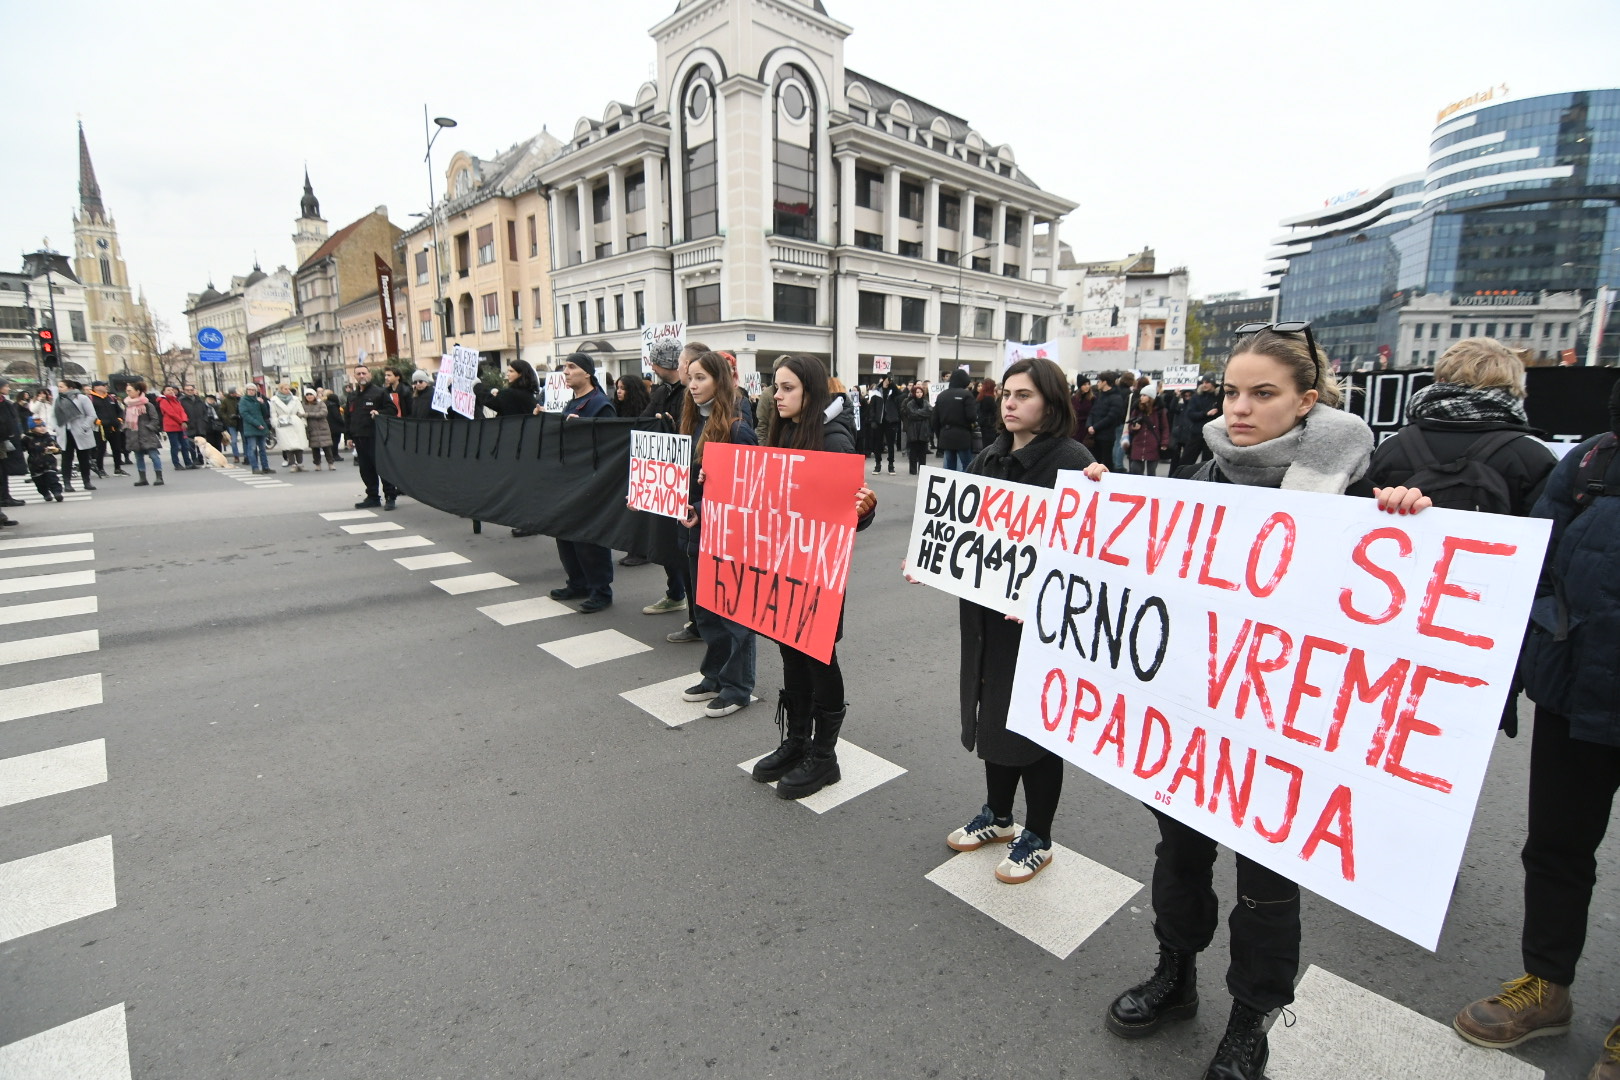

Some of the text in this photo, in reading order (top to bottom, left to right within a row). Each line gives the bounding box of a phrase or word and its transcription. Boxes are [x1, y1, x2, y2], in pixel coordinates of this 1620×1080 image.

[629, 481, 688, 518] DRŽAVOM
[630, 458, 689, 491] PUSTOM
[731, 449, 806, 515] НИЈЕ
[700, 497, 855, 594] УМЕТНИЧКИ
[922, 519, 955, 543] АКО
[924, 475, 1047, 546] БЛОКАДА
[917, 530, 1037, 601] НЕ САДА?
[1048, 487, 1518, 651] RAZVILO SE
[712, 555, 821, 649] ЋУТАТИ
[1036, 568, 1491, 795] CRNO VREME
[1040, 667, 1356, 883] OPADANJA
[1154, 790, 1172, 806] DIS
